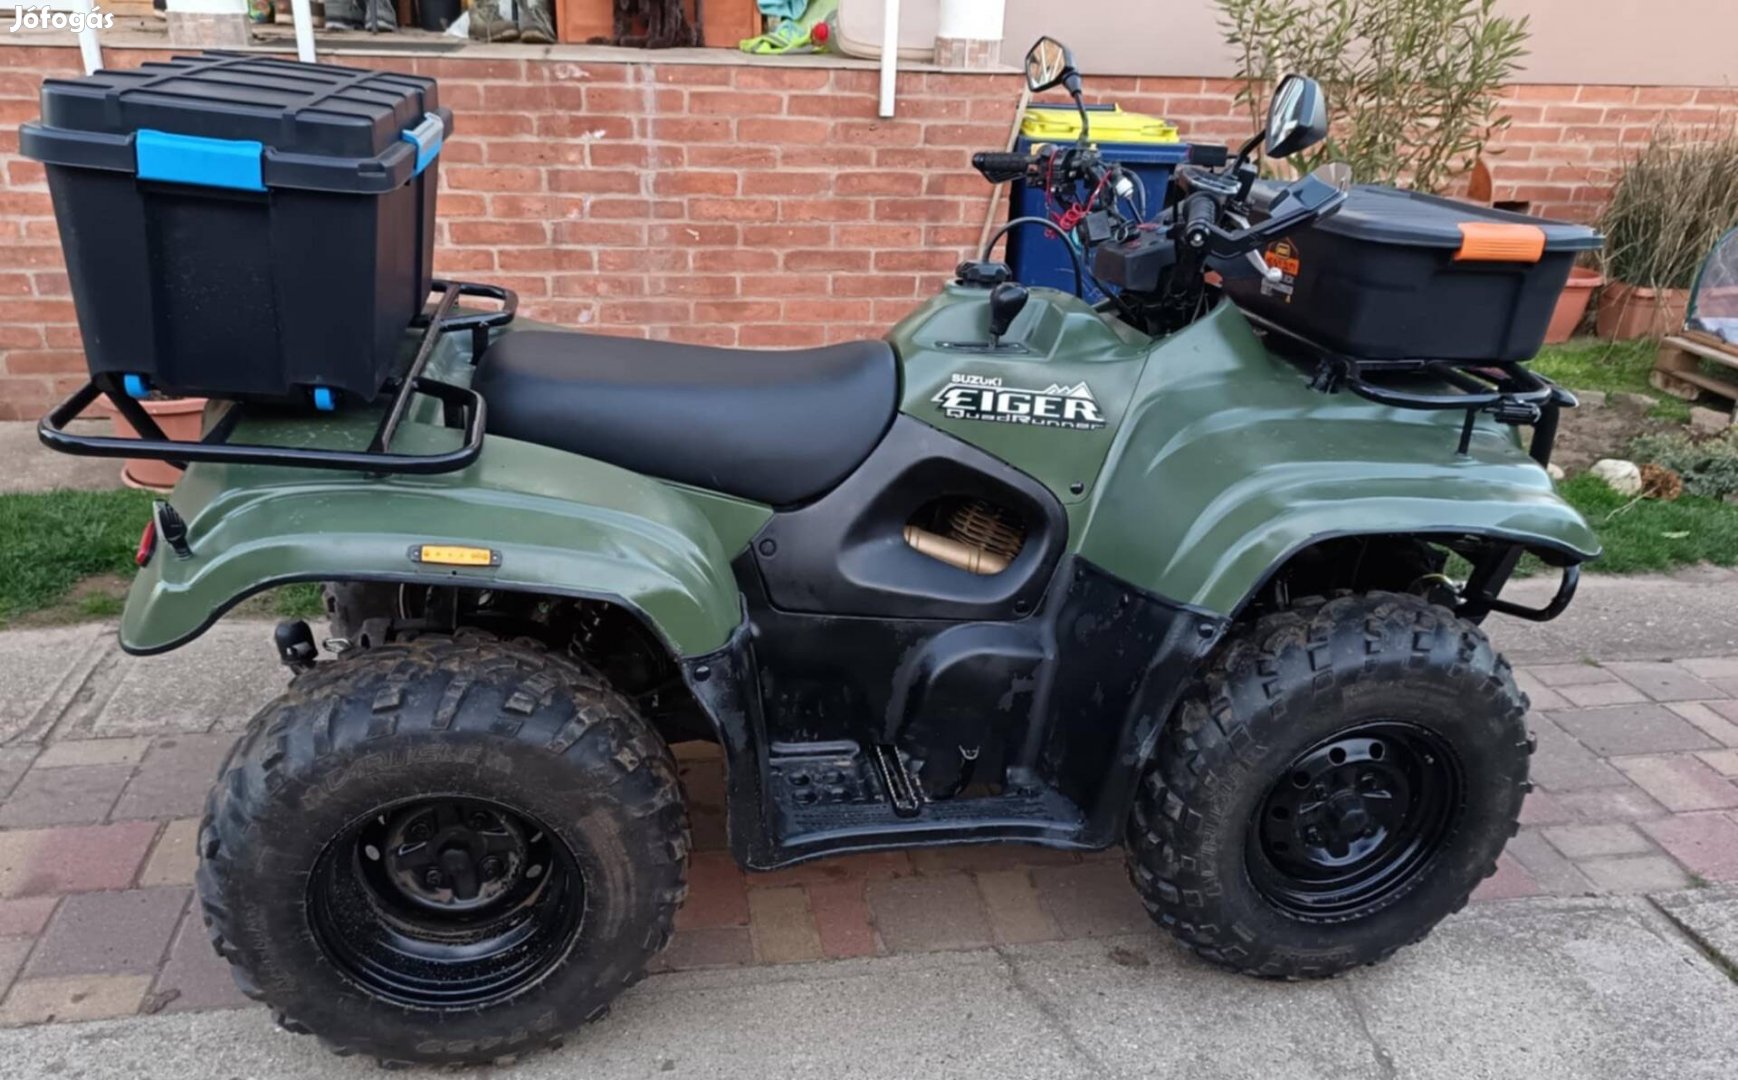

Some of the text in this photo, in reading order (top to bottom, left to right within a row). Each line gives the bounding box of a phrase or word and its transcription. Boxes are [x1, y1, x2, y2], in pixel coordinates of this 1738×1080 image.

[951, 373, 1003, 386] SUZUKI
[942, 388, 1106, 422] EIGER
[945, 408, 1105, 430] QuadRunner
